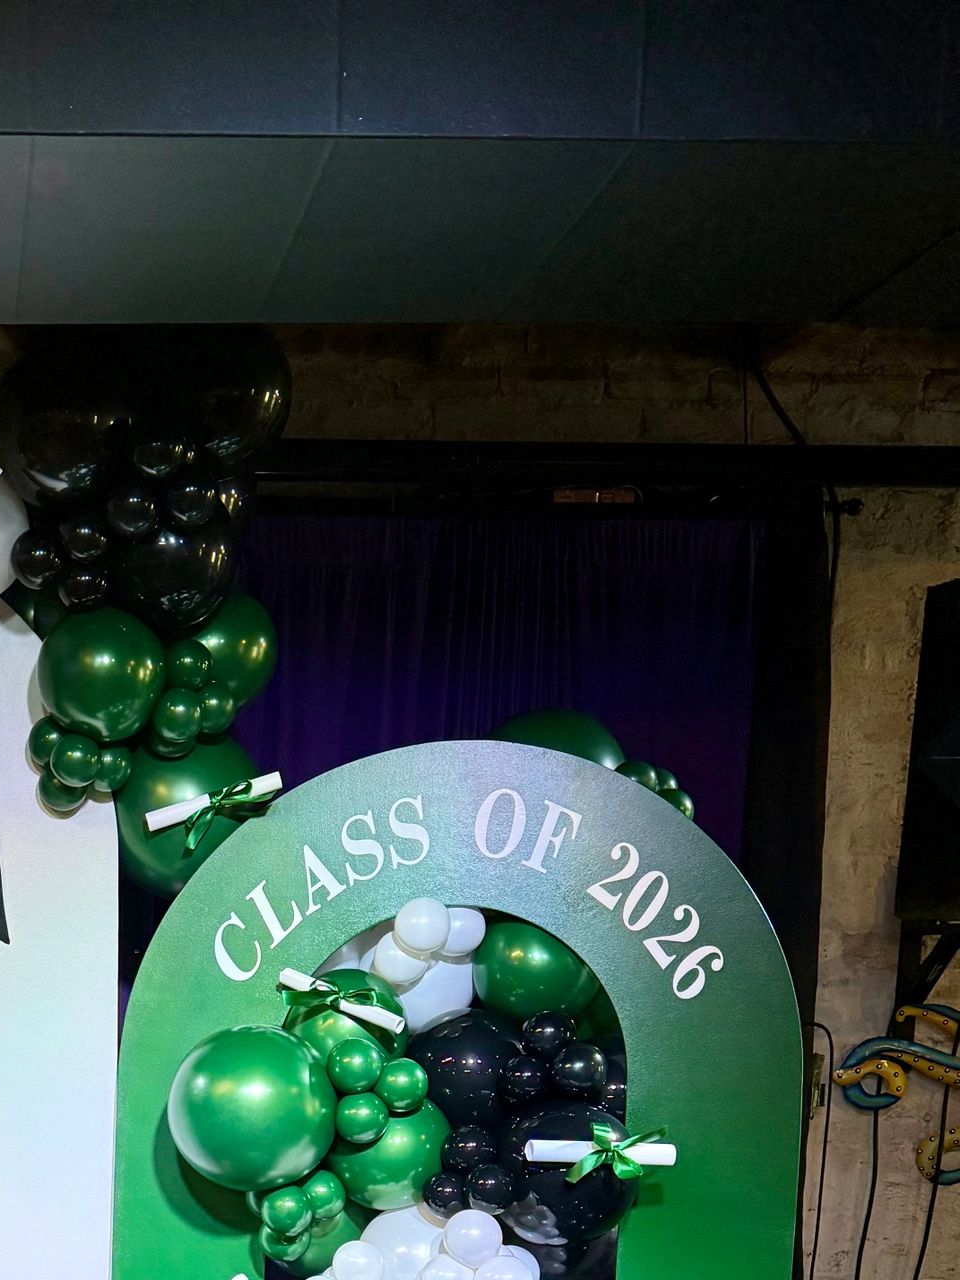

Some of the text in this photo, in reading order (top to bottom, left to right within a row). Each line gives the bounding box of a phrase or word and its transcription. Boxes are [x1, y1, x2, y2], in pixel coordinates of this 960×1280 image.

[213, 787, 725, 1000] CLASS OF 2026
